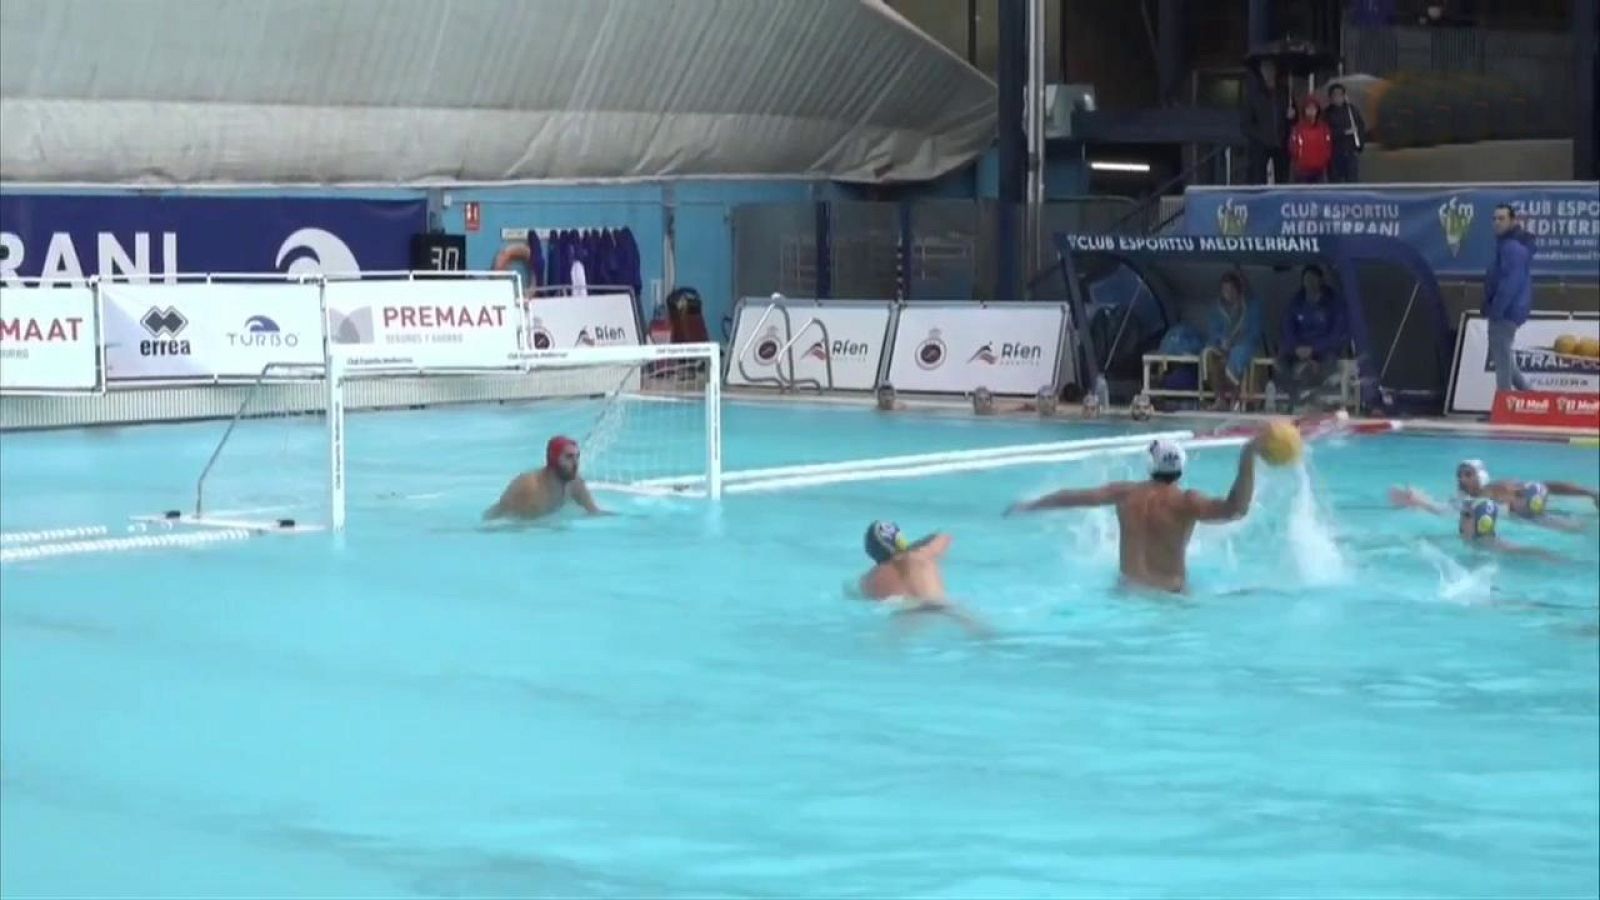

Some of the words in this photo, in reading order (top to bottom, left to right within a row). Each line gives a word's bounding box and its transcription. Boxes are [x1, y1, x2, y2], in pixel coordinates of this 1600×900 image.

[1281, 202, 1318, 218] CLUB
[1324, 203, 1400, 219] ESPORTIU
[1281, 220, 1400, 237] MEDITERRANI
[1077, 235, 1115, 250] CLUB
[1120, 236, 1195, 251] ESPORTIU
[1200, 237, 1320, 252] MEDITERRANI
[431, 246, 460, 271] 30
[383, 305, 507, 328] PREMAAT
[0, 317, 83, 341] MAAT
[226, 332, 299, 347] TURBO
